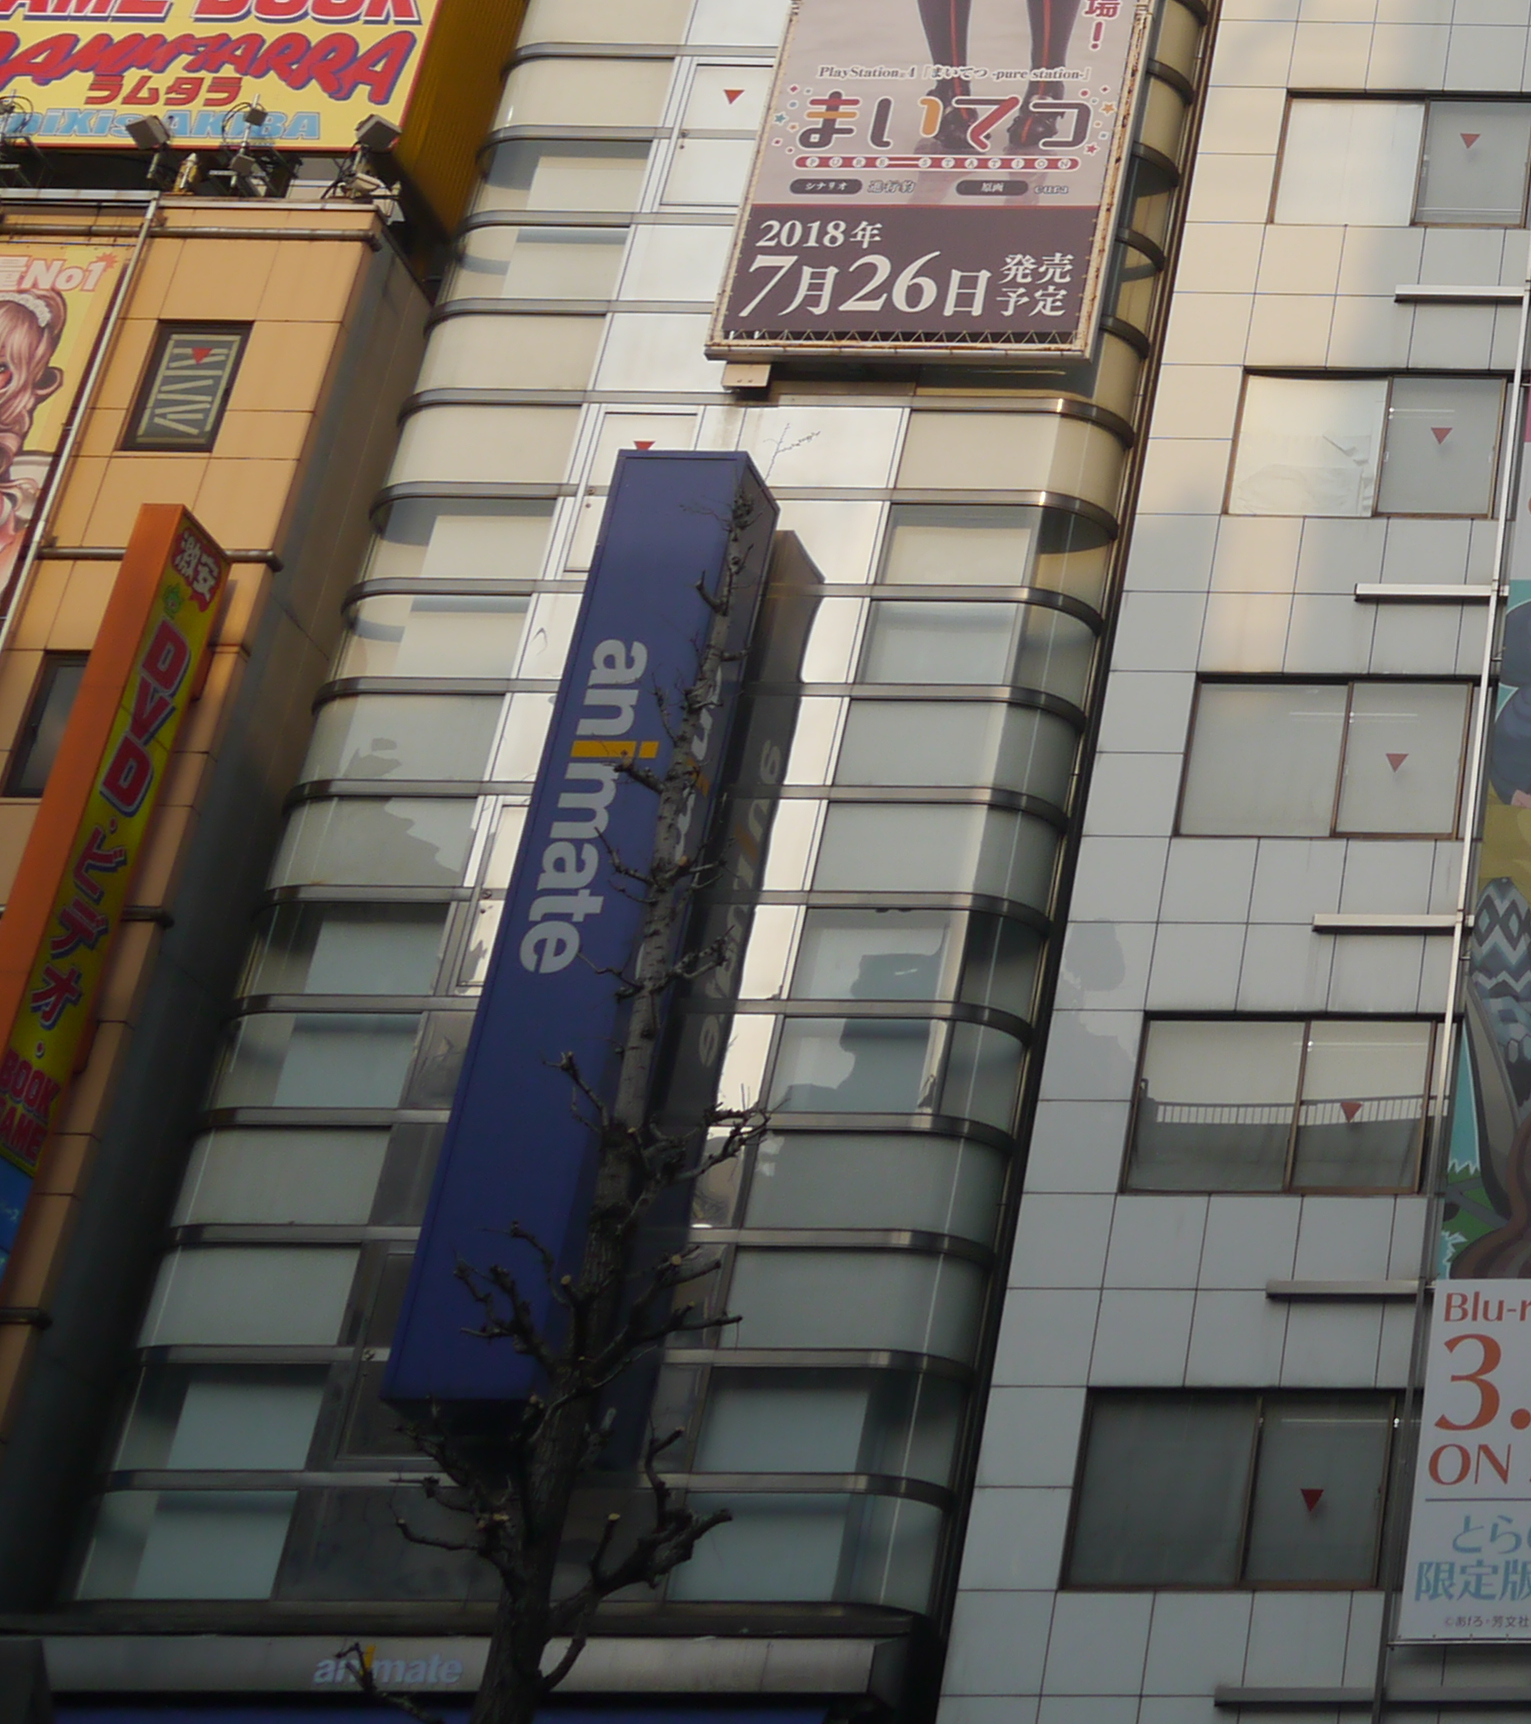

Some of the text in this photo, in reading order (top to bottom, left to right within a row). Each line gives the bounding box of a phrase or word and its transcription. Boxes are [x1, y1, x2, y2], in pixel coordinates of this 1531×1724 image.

[84, 75, 243, 105] ラムタラ
[797, 90, 1093, 151] まいてつ
[806, 157, 1072, 170] PURE STATION
[804, 180, 849, 191] シナリオ
[981, 182, 1004, 193] 原画
[756, 219, 882, 249] 2018年
[738, 250, 992, 318] 7月26日
[999, 253, 1074, 285] 発売
[996, 286, 1067, 317] 予定
[175, 528, 222, 597] 激安
[520, 637, 659, 975] animate
[1428, 1443, 1511, 1486] ON
[313, 1645, 464, 1684] animate
